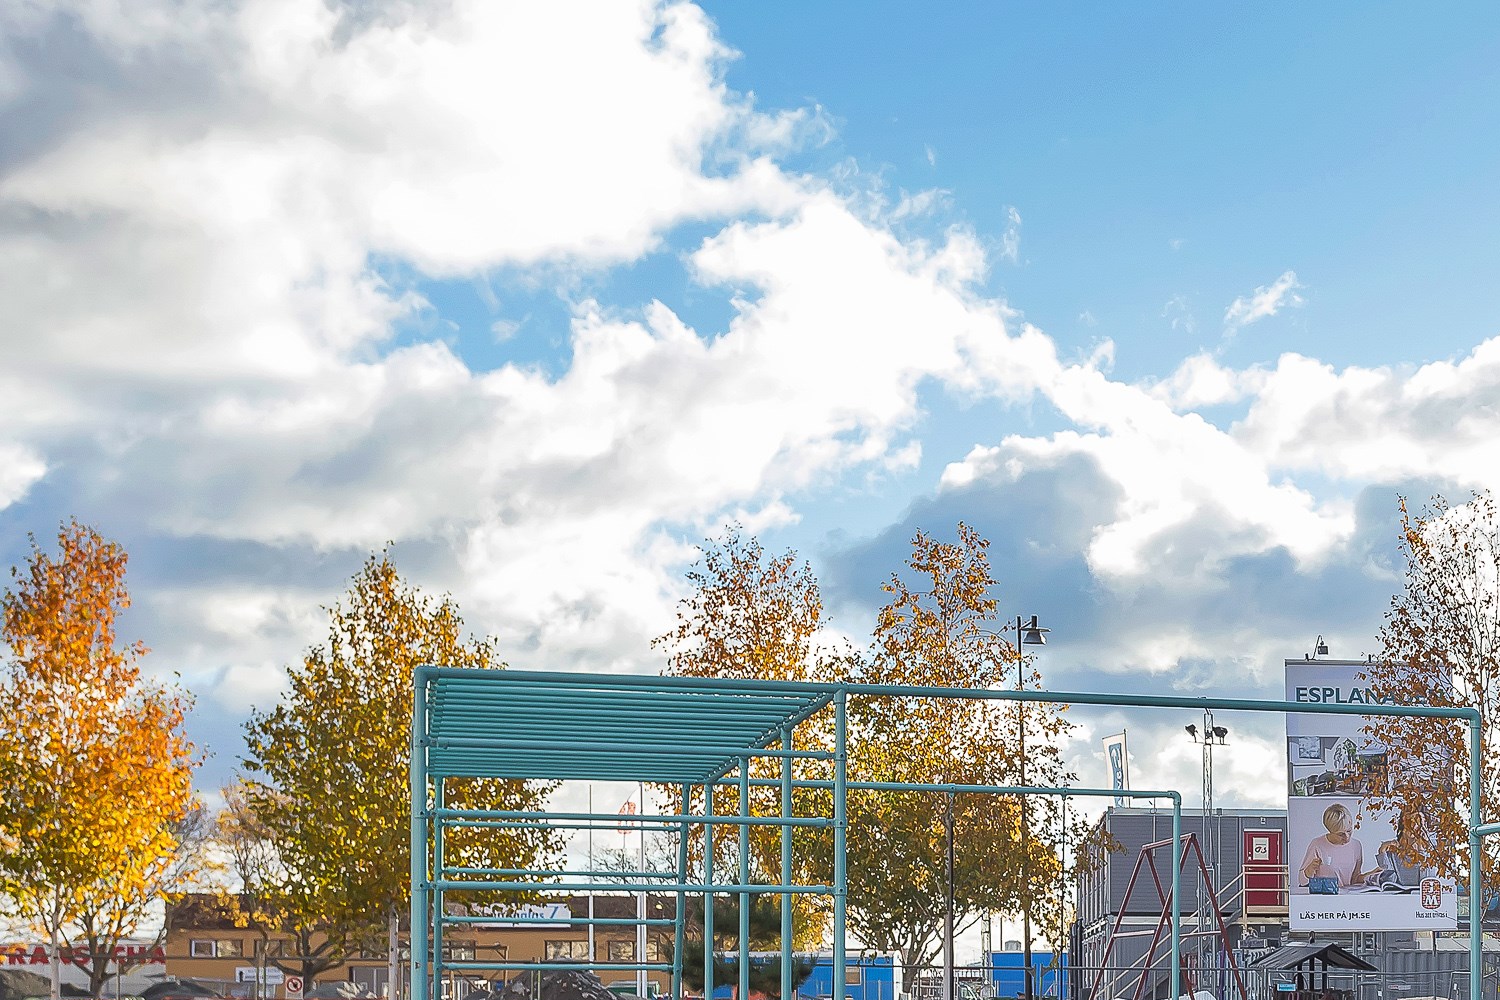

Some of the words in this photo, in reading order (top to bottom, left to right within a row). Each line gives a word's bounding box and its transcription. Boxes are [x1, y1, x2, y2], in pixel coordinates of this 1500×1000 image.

[1299, 910, 1316, 920] LÄS
[1317, 912, 1335, 920] MER
[1336, 910, 1347, 919] PÅ
[1348, 912, 1371, 921] JM.SE
[1415, 911, 1424, 919] Hus
